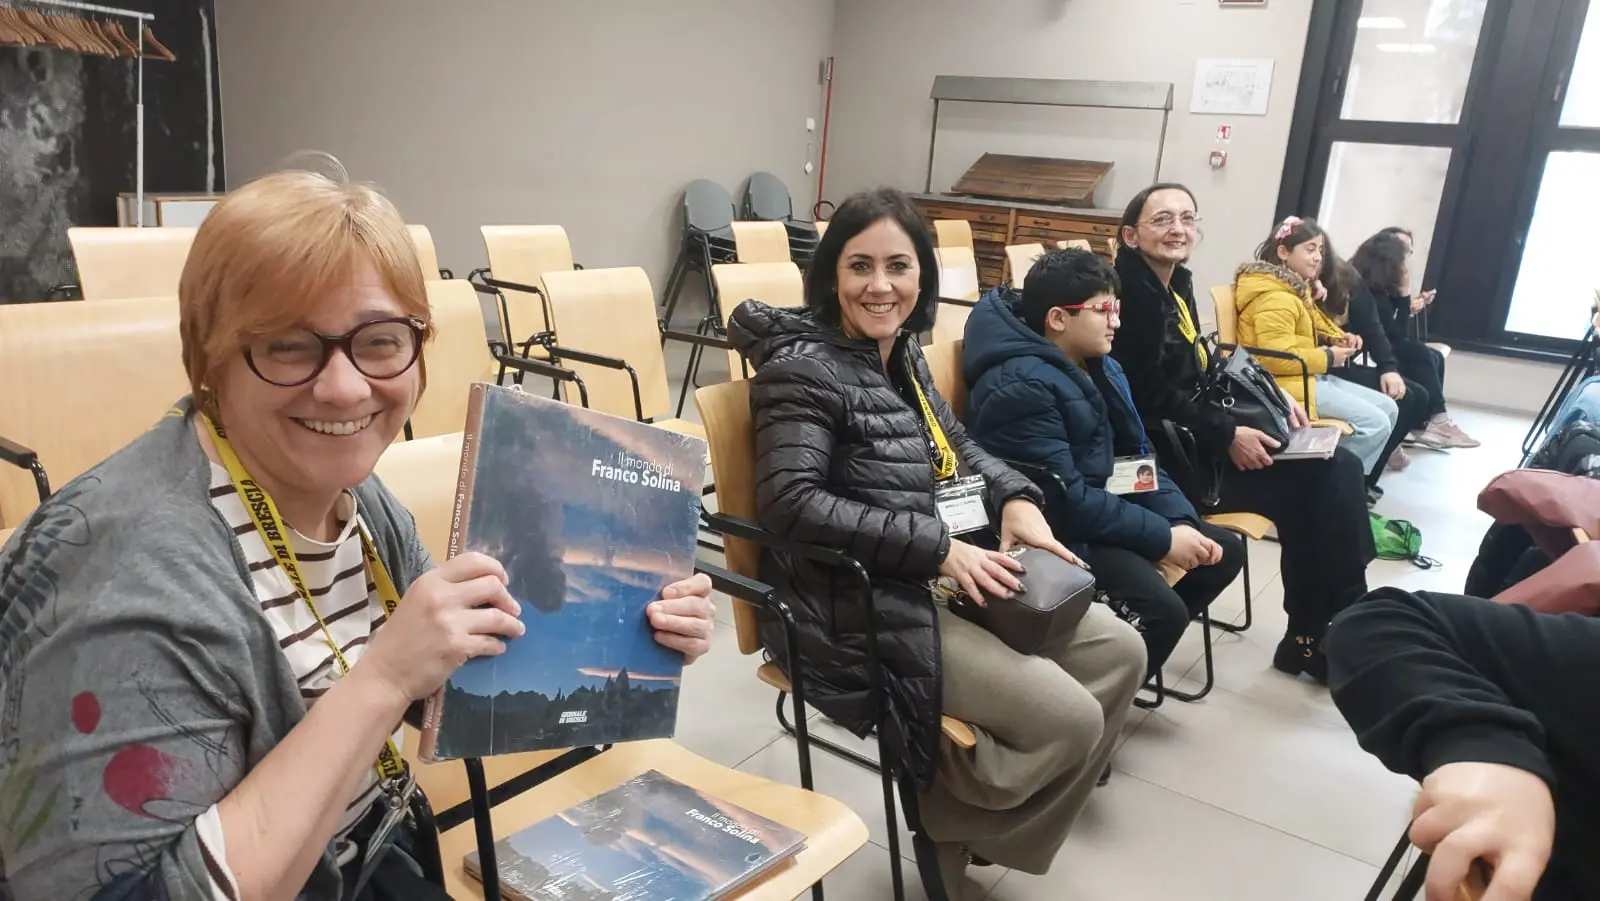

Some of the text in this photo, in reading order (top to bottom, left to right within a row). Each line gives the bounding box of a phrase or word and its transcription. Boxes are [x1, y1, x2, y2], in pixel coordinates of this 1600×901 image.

[460, 442, 473, 479] mondo
[591, 458, 681, 492] Franco Solina
[626, 457, 662, 474] mondo
[664, 462, 674, 476] di
[459, 480, 467, 491] di
[240, 479, 283, 541] BRESCIA
[453, 493, 465, 529] Franco
[273, 545, 291, 560] DI
[449, 532, 460, 559] Solin
[685, 808, 760, 844] Franco Solina
